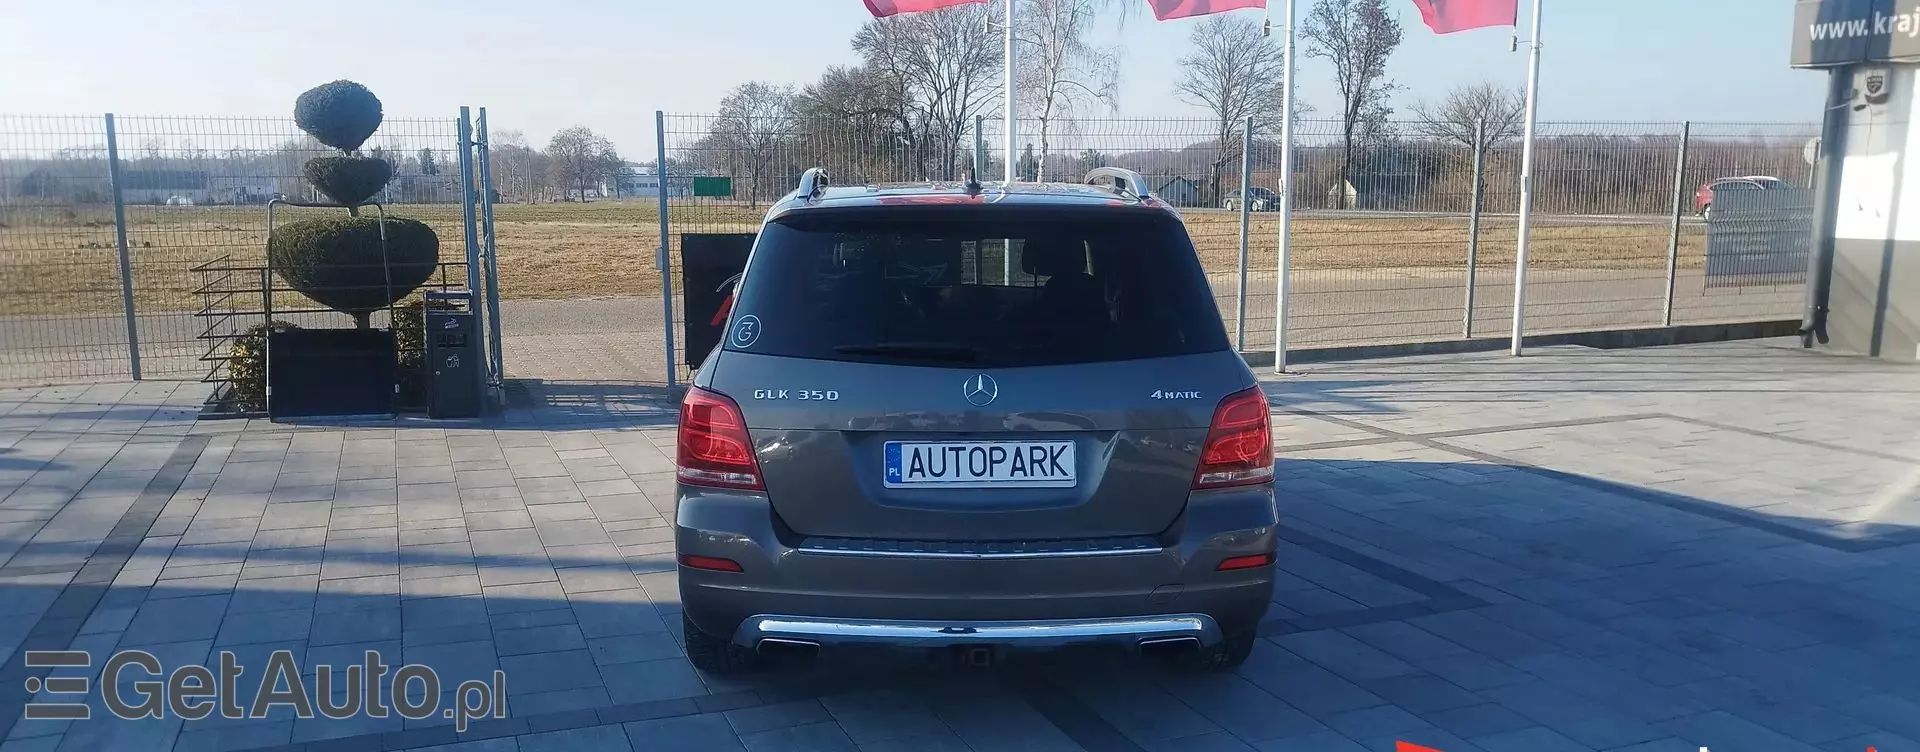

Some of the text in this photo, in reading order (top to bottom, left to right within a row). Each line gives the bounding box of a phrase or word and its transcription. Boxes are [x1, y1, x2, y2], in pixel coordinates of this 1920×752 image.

[753, 389, 839, 401] GLK 350
[1151, 389, 1202, 400] 4MATIC
[908, 445, 1068, 478] AUTOPARK
[889, 468, 900, 477] PL
